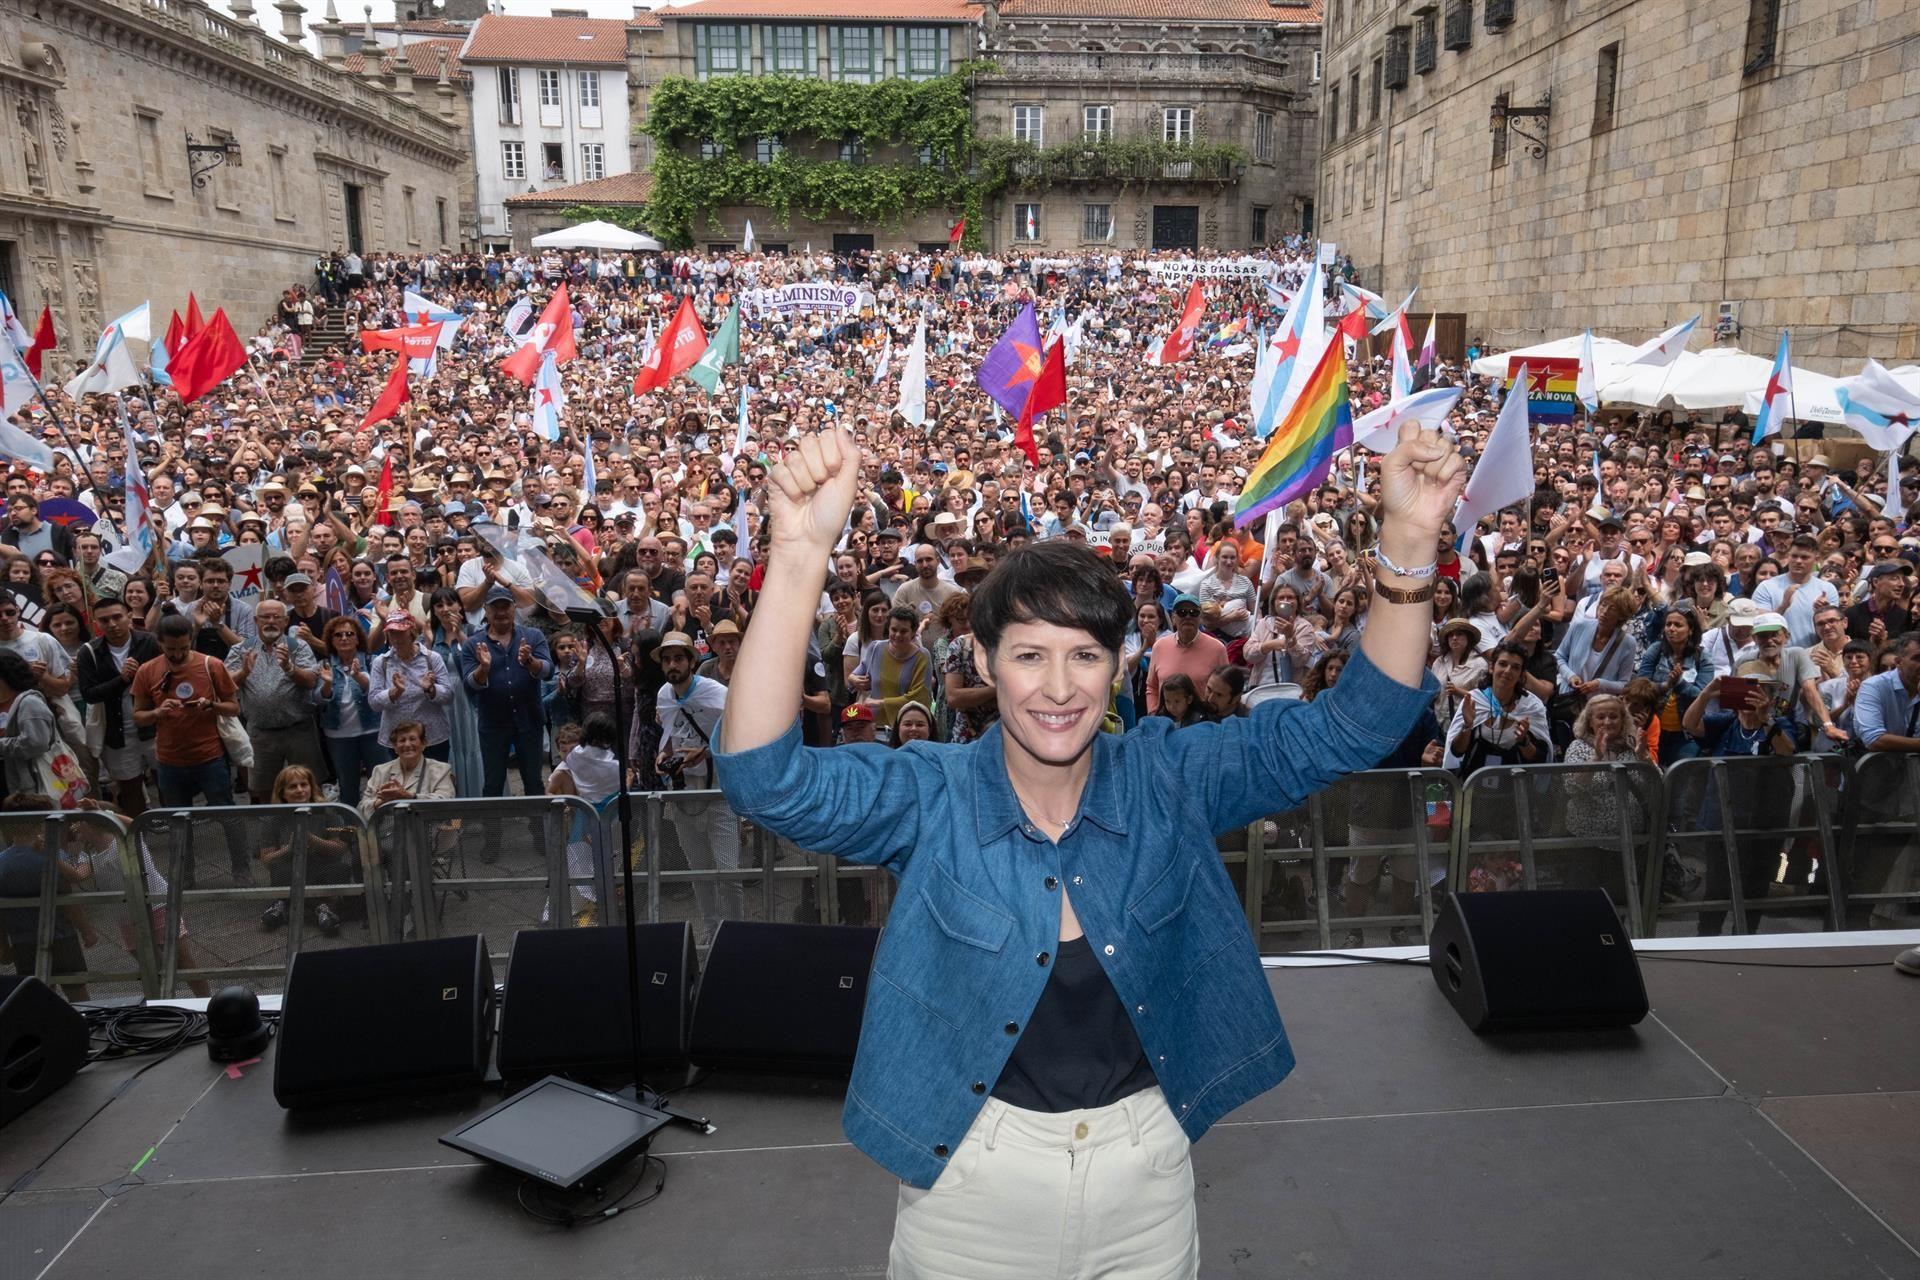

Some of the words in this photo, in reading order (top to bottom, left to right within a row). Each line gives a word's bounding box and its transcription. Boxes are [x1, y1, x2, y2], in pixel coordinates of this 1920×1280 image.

[1163, 263, 1188, 272] NON
[1210, 264, 1258, 275] BALSAS
[1528, 391, 1542, 401] ZA
[1546, 392, 1573, 402] NOVA
[1146, 541, 1165, 554] PÚB
